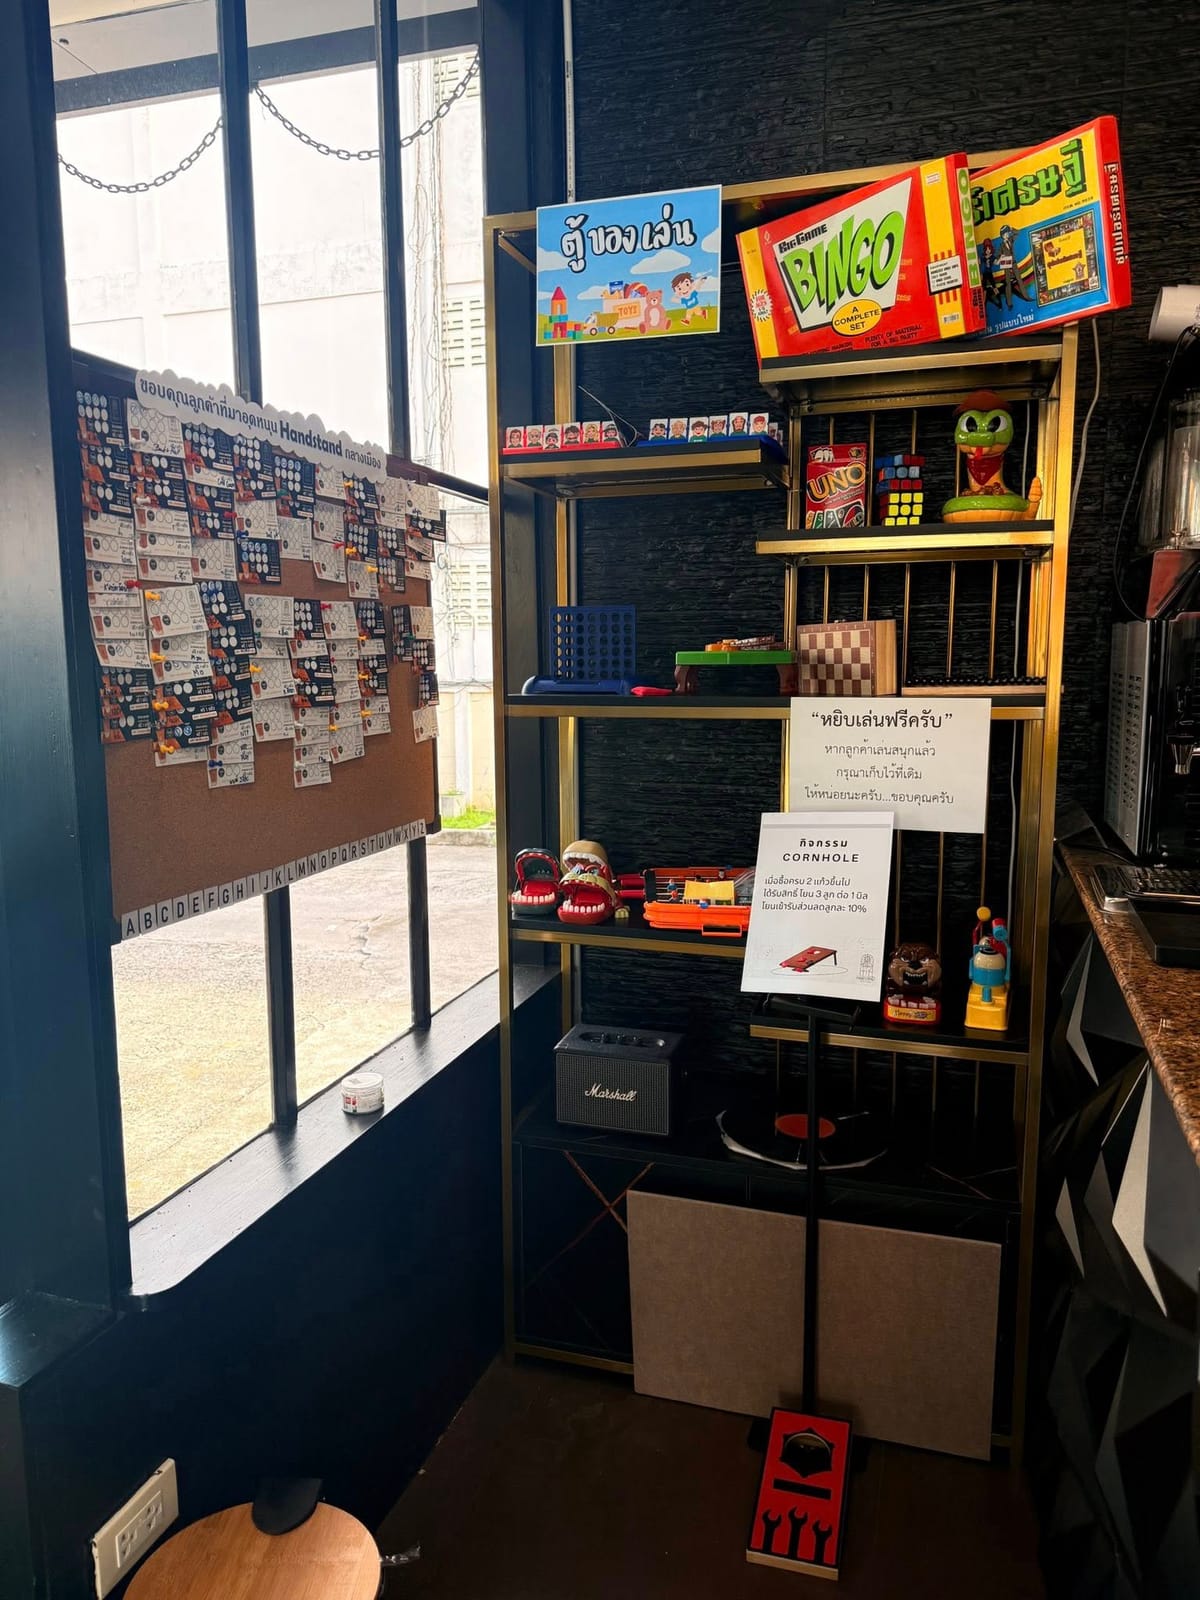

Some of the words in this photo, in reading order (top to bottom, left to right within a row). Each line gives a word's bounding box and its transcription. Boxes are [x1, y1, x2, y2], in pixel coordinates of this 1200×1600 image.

[958, 169, 980, 287] BINGO
[780, 211, 904, 315] BINGO
[834, 309, 880, 327] COMPLETE
[852, 306, 859, 314] A
[850, 321, 866, 331] SET
[280, 420, 343, 457] Handstand
[345, 448, 381, 469] กลางเมือง
[808, 462, 866, 501] UNO
[825, 738, 936, 760] หากลูกค้าเล่นสนุกแล้ว
[836, 763, 922, 781] กรุณาเก็บไว้ที่เดิม
[800, 838, 848, 848] กิจกรรม
[783, 853, 859, 863] CORNHOLE
[765, 874, 804, 885] เมื่อซื้อครบ
[806, 877, 813, 885] 2
[814, 876, 851, 887] แก้วขึ้นไป
[800, 889, 814, 898] โยน
[815, 890, 822, 898] 3
[823, 891, 835, 901] ลูก
[836, 890, 849, 900] ต่อ
[851, 891, 855, 899] 1
[856, 891, 868, 900] บิล
[762, 901, 846, 913] โยนเข้ารับส่วนลดลูกละ
[848, 904, 867, 913] 10%
[584, 1083, 637, 1101] Marshall
